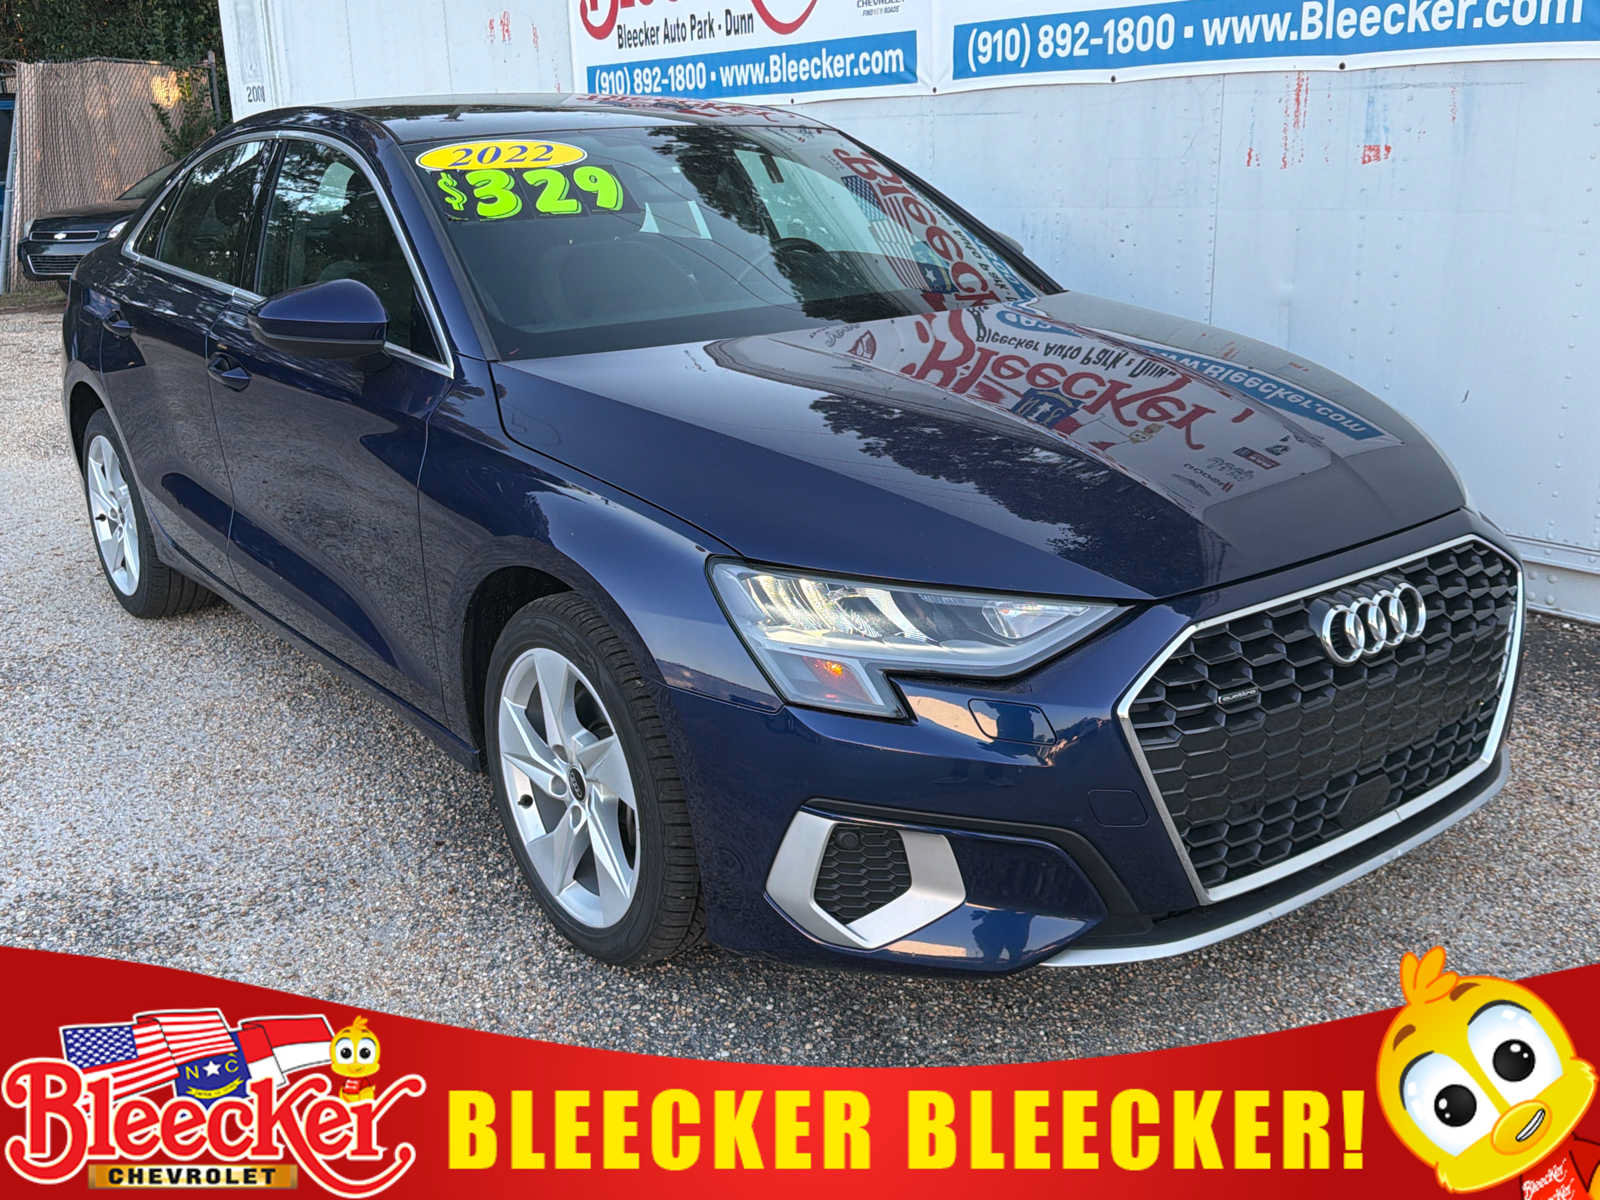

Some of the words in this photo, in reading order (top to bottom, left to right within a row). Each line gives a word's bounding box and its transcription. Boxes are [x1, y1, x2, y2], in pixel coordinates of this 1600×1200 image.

[617, 20, 660, 49] Bleecker
[663, 17, 687, 44] Auto
[690, 12, 715, 41] Park
[725, 9, 754, 36] Dunn
[968, 22, 1030, 72] (910)
[1038, 13, 1176, 59] 892-1800
[1202, 0, 1583, 46] www.Bleecker.com
[595, 66, 630, 95] (910)
[633, 62, 707, 94] 892-1800
[720, 48, 905, 87] www.Bleecker.com
[448, 144, 554, 167] 2022
[437, 166, 623, 219] $329
